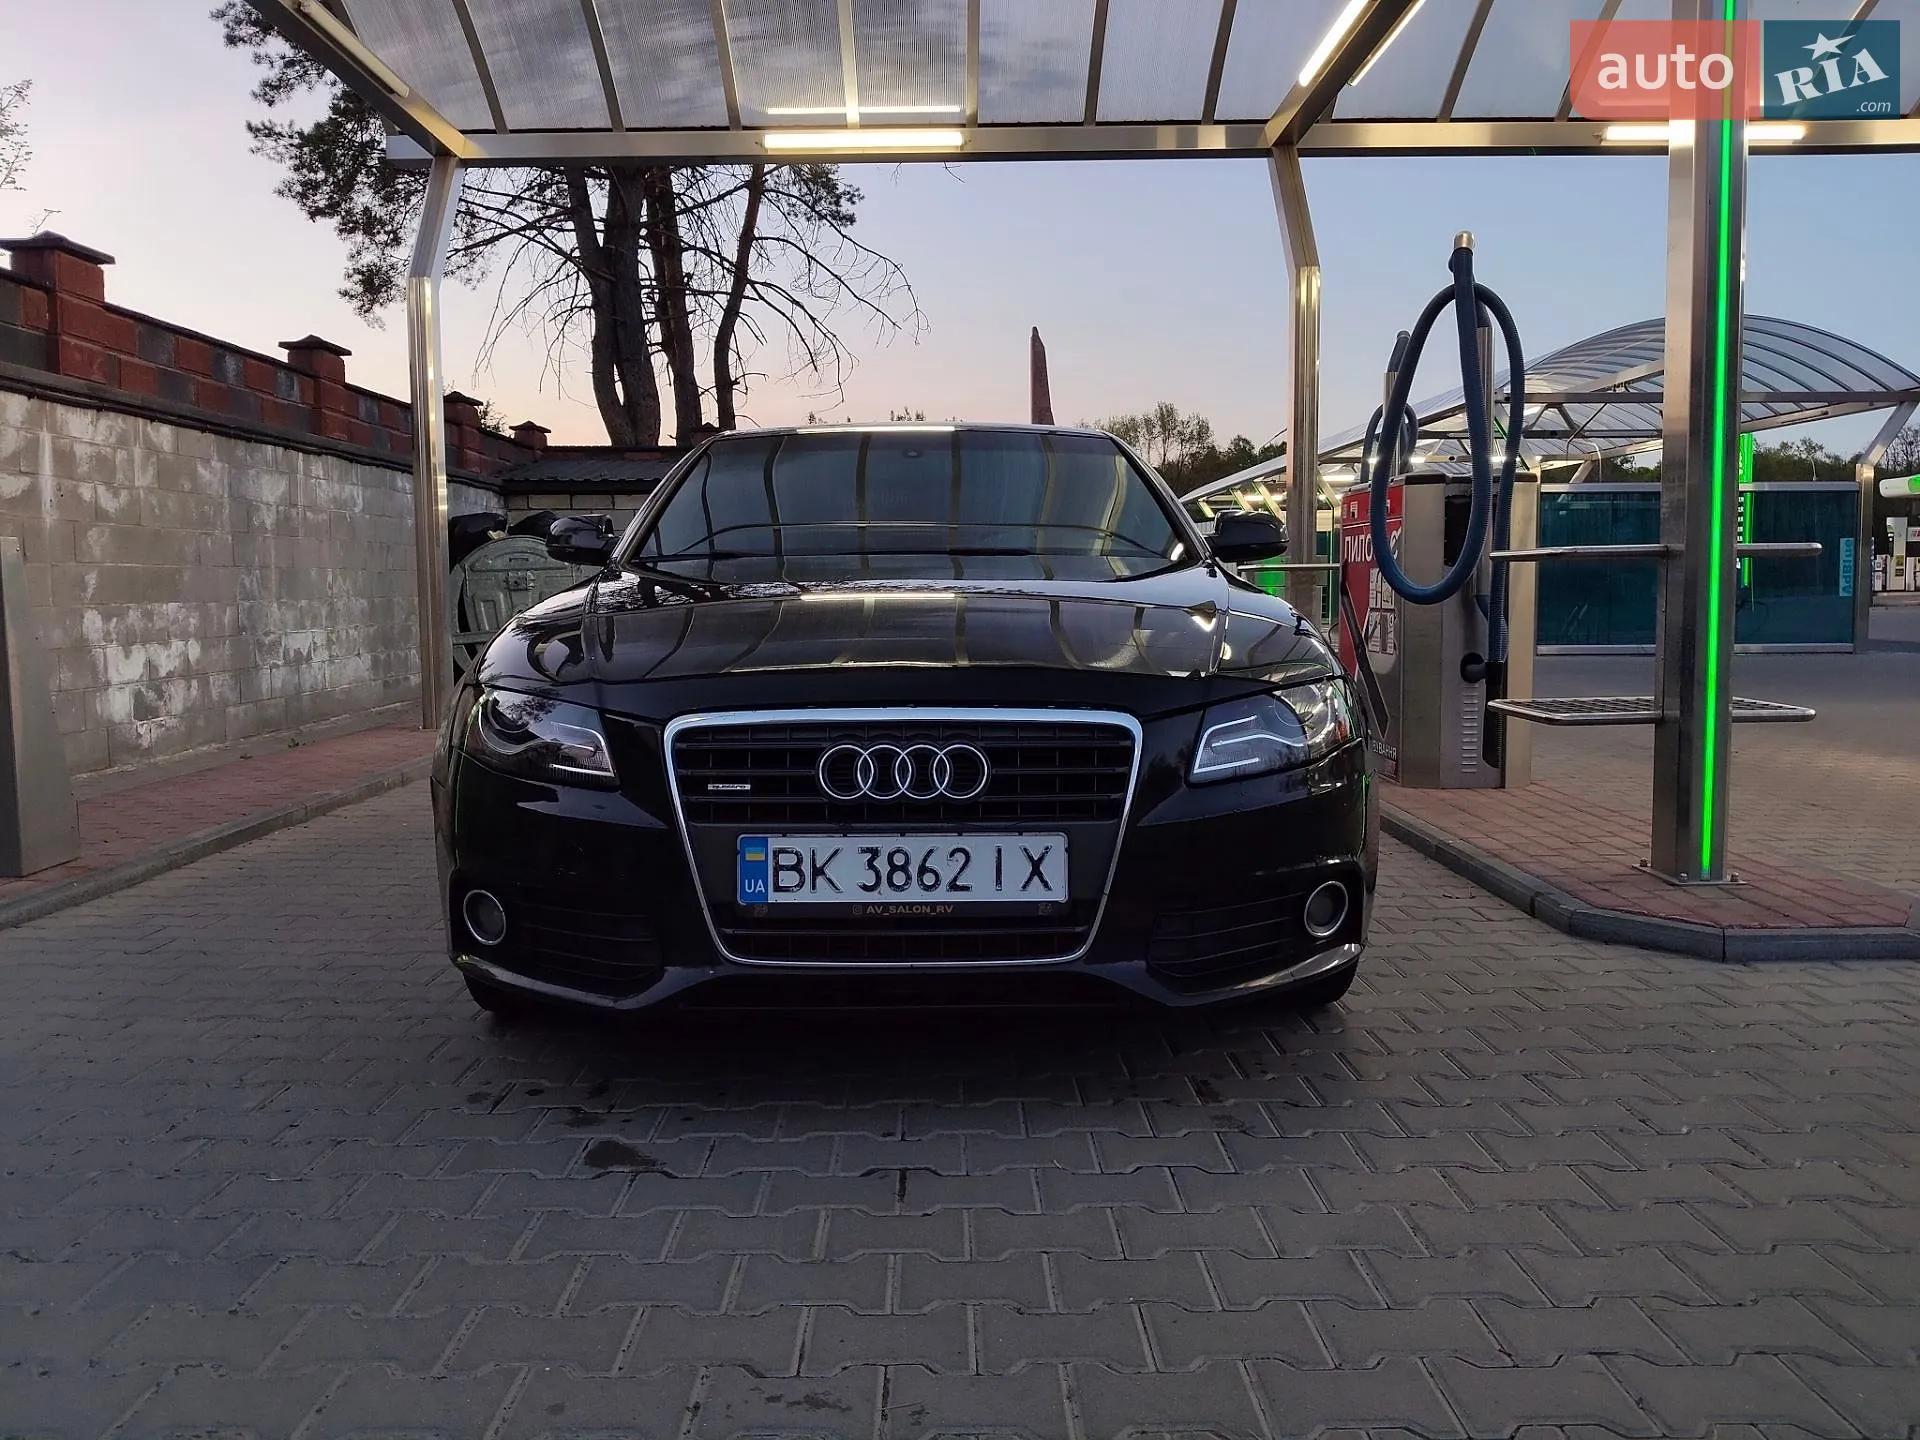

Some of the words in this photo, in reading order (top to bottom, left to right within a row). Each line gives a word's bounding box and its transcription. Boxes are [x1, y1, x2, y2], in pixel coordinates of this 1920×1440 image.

[771, 846, 843, 893] BK
[857, 846, 973, 893] 3862
[995, 845, 1054, 892] IX
[745, 880, 765, 894] UA
[866, 905, 954, 916] AV_SALON_RV
